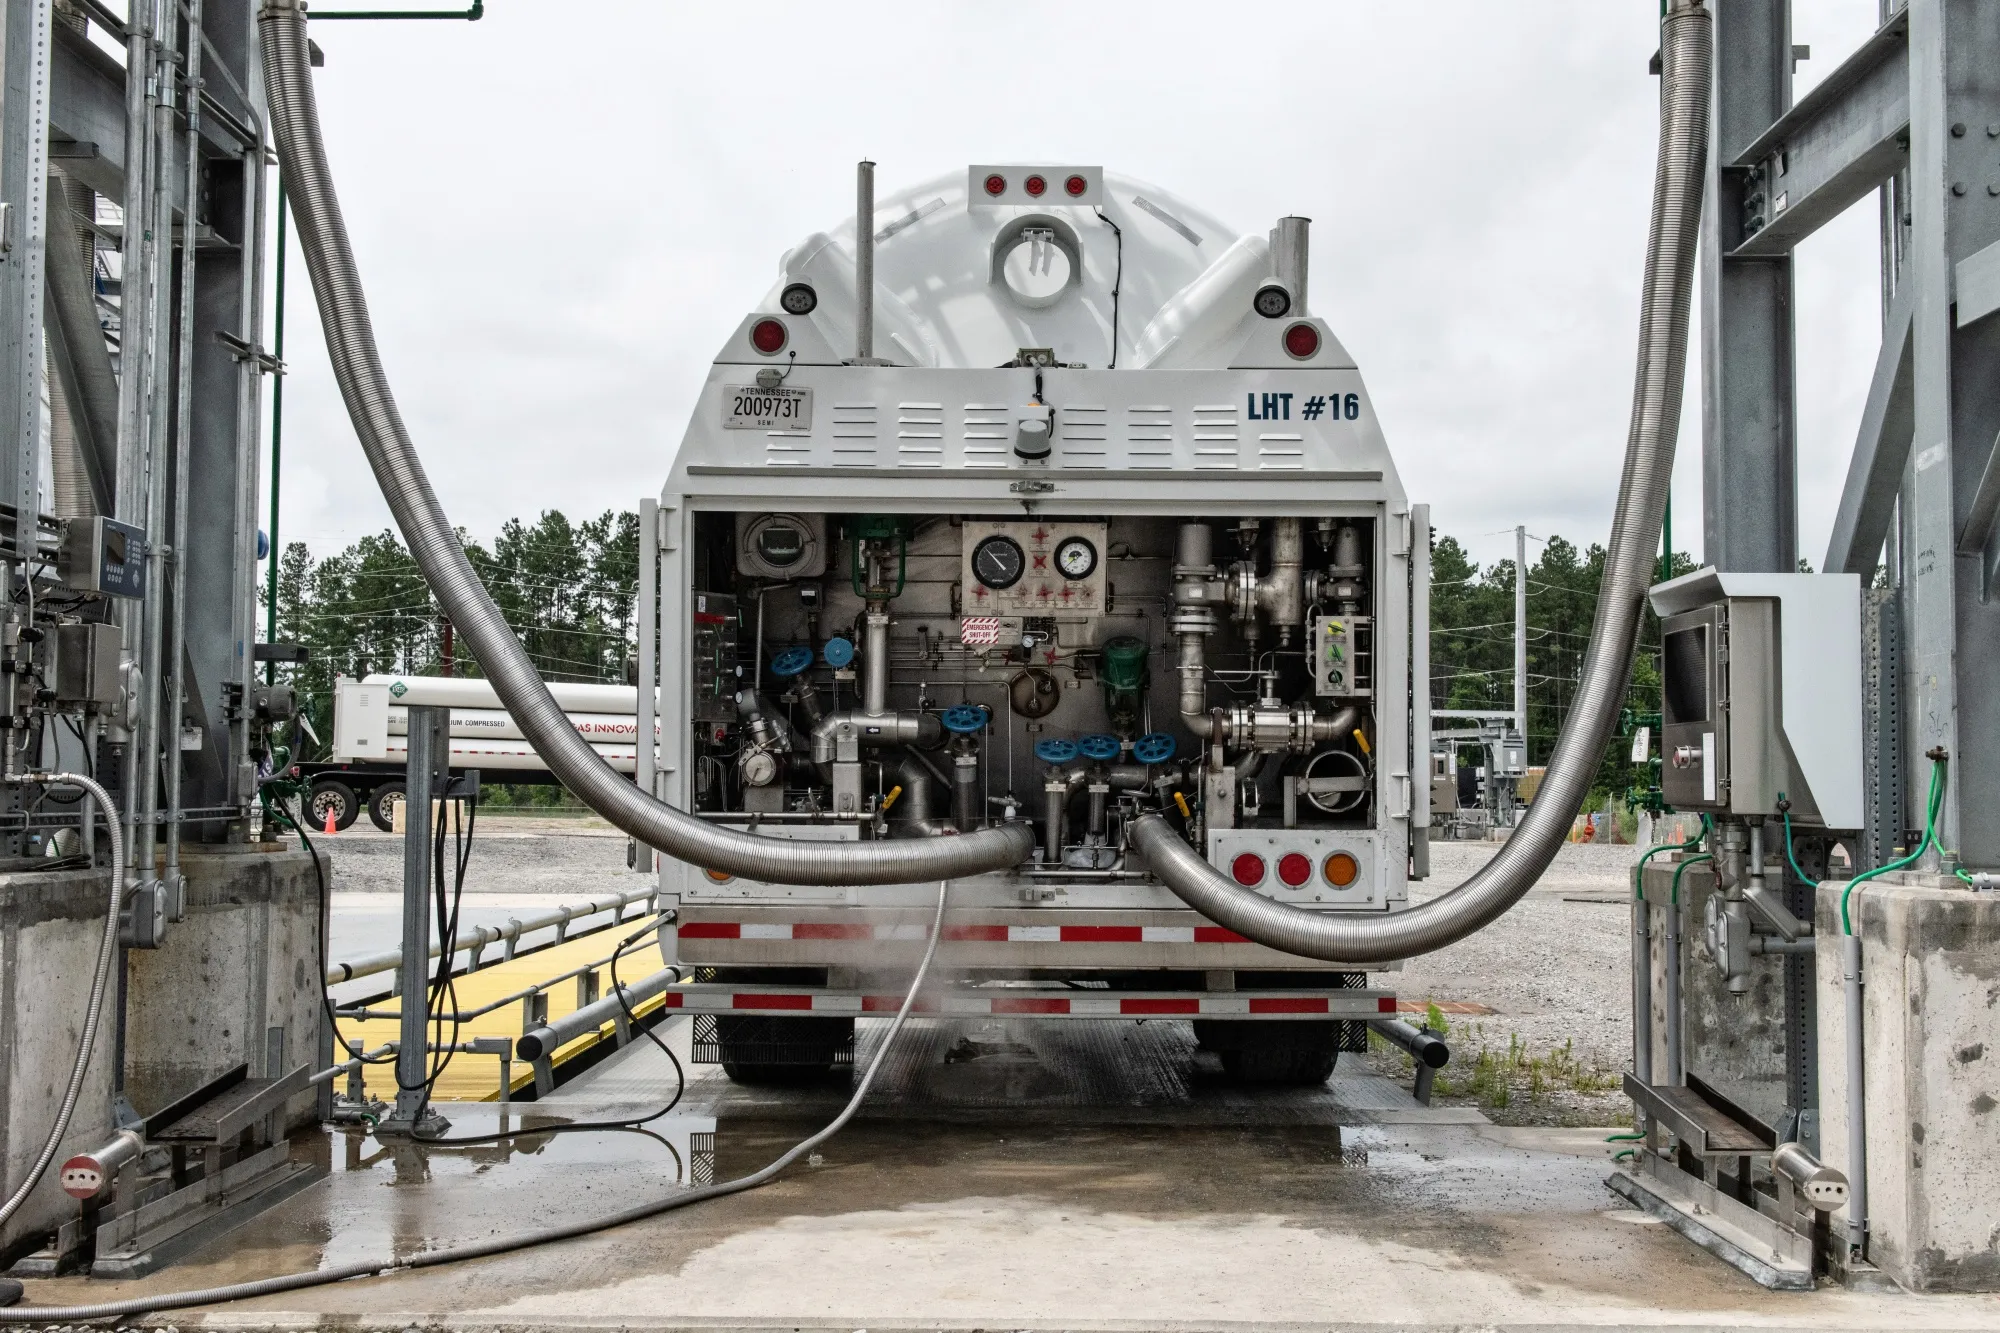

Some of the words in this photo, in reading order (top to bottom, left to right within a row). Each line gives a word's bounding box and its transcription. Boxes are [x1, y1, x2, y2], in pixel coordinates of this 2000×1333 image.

[745, 387, 791, 397] TENNESSEE
[733, 396, 802, 418] 200973T
[1247, 392, 1294, 421] LHT
[1301, 392, 1360, 421] #16
[465, 719, 505, 727] COMPRESSED
